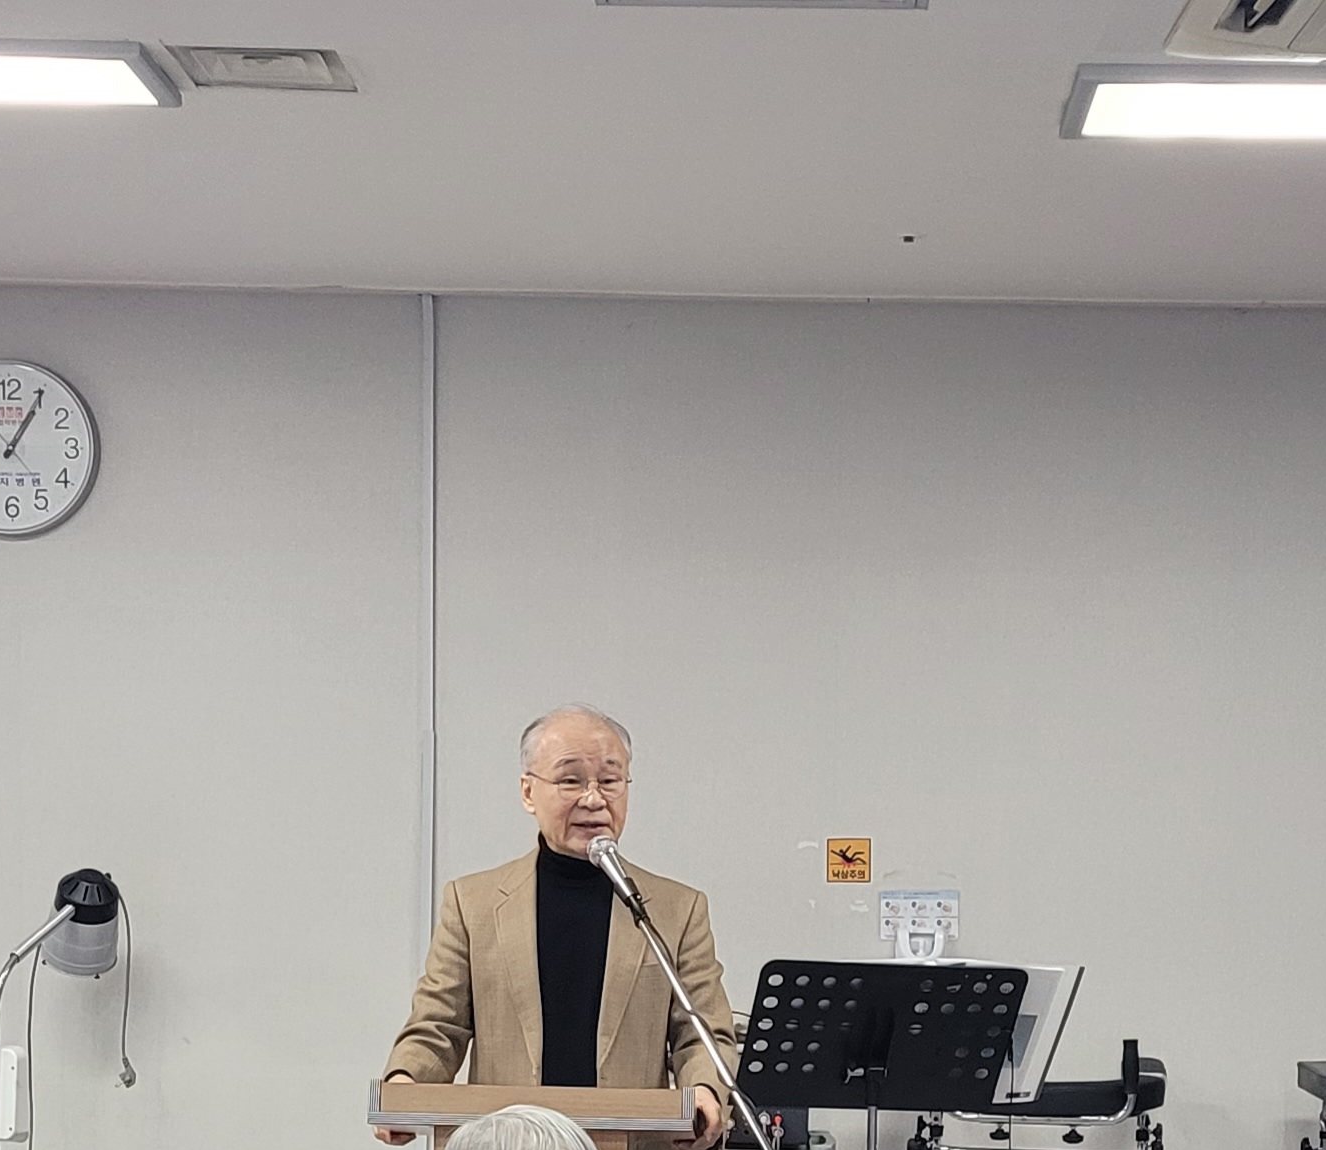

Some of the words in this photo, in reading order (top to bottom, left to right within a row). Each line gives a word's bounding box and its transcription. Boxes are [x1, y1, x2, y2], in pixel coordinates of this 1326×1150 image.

[54, 407, 70, 430] 2
[64, 437, 80, 459] 3
[55, 467, 70, 489] 4
[4, 496, 20, 518] 6
[33, 489, 49, 510] 5
[831, 869, 865, 879] 낙상주의
